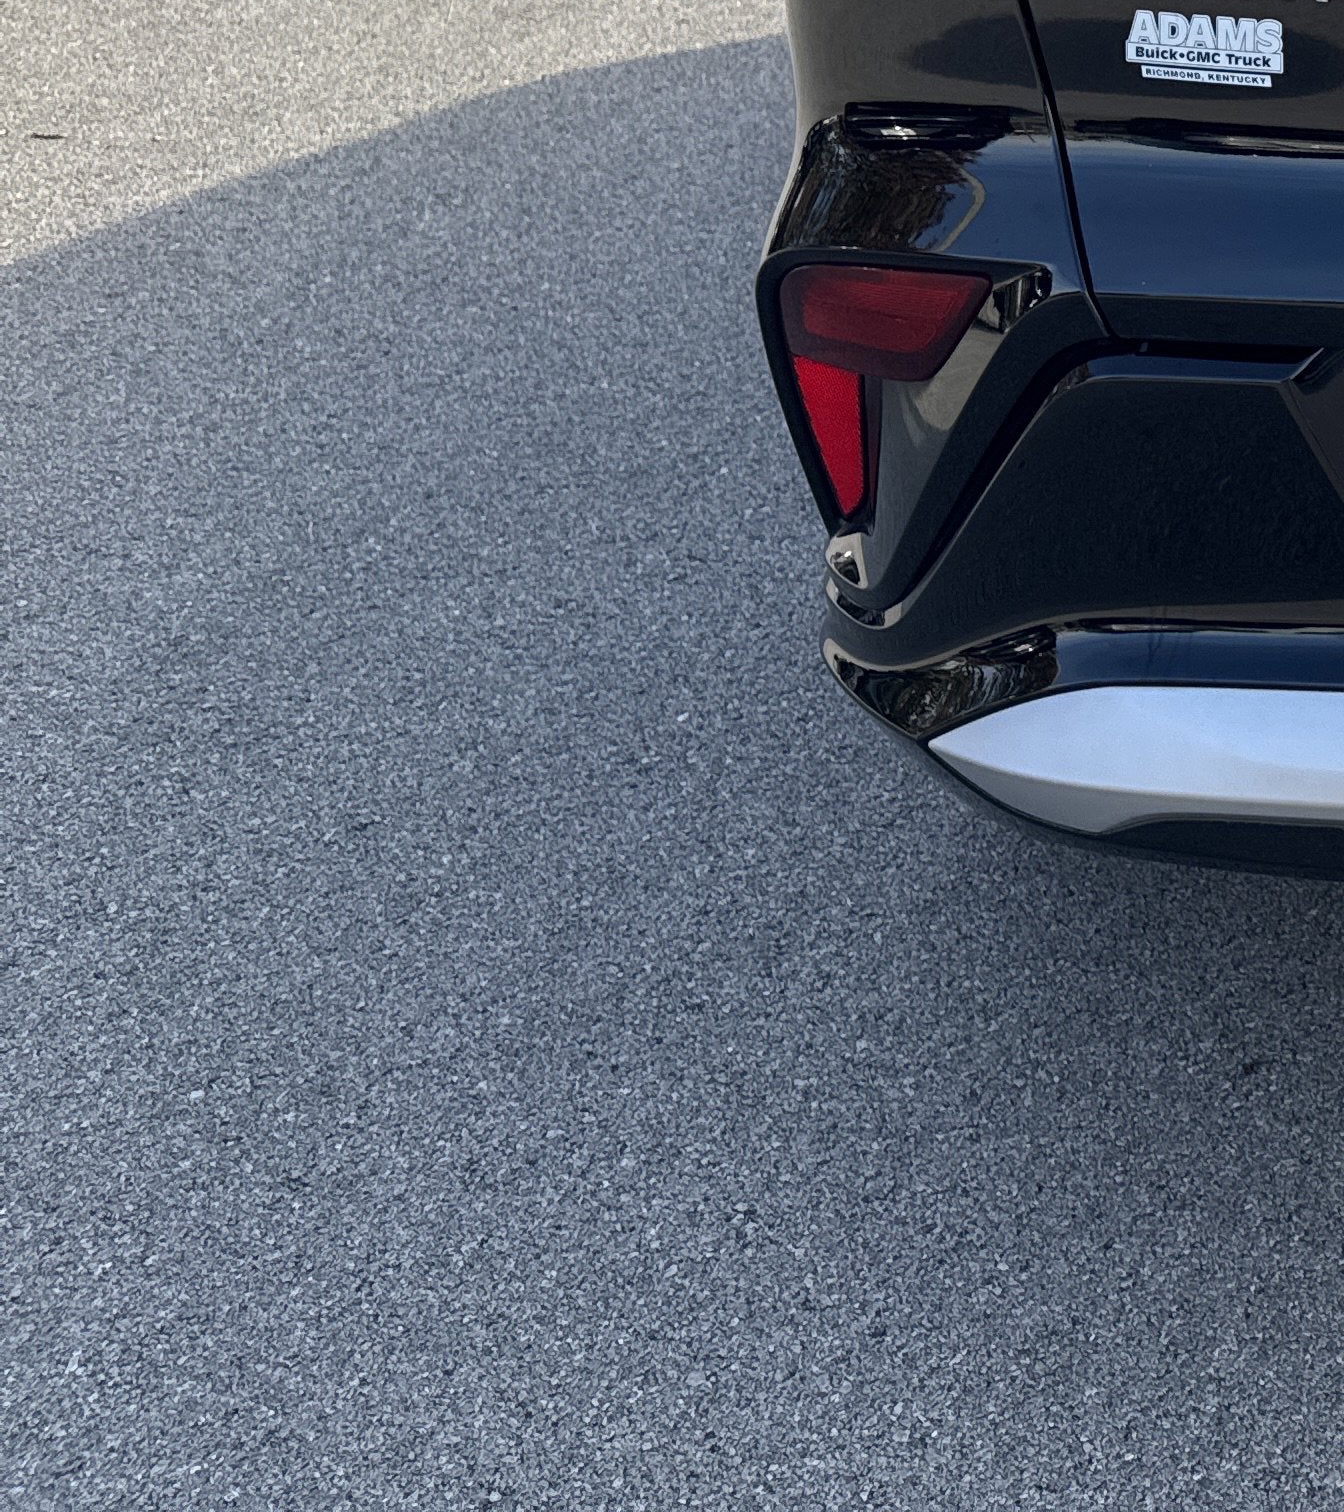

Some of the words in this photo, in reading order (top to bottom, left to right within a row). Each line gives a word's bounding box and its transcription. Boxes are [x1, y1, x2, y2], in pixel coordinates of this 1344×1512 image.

[1127, 10, 1284, 54] ADAMS
[1226, 52, 1272, 69] Truck
[1207, 73, 1267, 86] KENTUCKY
